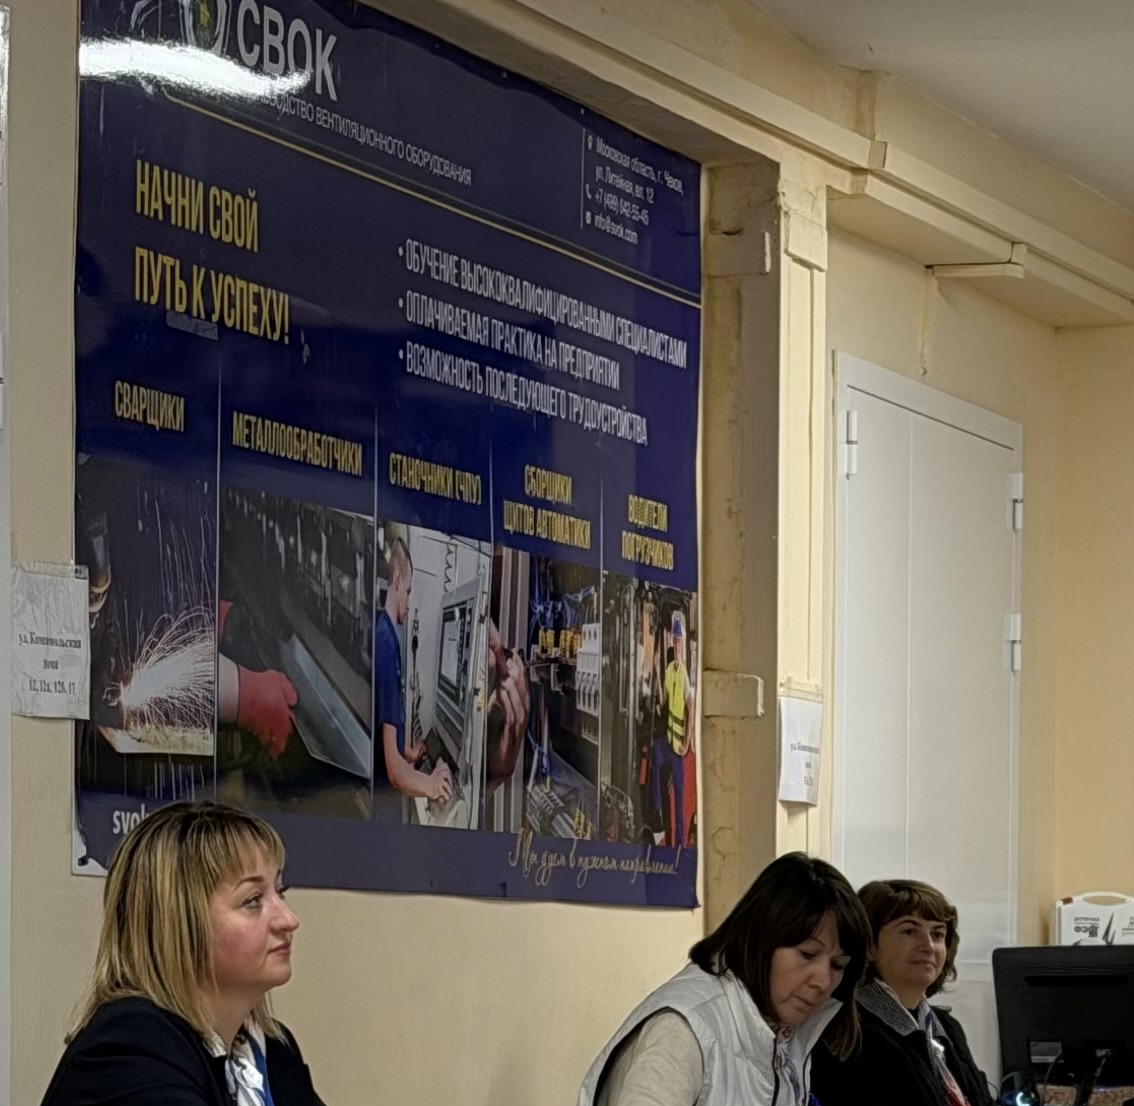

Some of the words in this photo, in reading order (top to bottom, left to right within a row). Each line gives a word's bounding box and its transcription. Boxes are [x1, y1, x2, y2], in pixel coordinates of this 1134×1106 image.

[237, 0, 338, 101] СВОК
[316, 106, 404, 159] ВЕНТИЛЯЦИОННОГО
[405, 141, 472, 187] ОБОРУДОВАНИЯ
[136, 159, 204, 235] НАЧНИ
[209, 186, 258, 253] СВОЙ
[135, 246, 188, 313] ПУТЬ
[192, 264, 206, 320] К
[210, 269, 289, 345] УСПЕХУ!
[405, 238, 459, 288] ОБУЧЕНИЕ
[460, 258, 614, 343] ВЫСОКОКВАЛИФИЦИРОВАННЫМИ
[615, 316, 688, 369] СПЕЦИАЛИСТАМИ
[406, 290, 489, 346] ОПЛАЧИВАЕМАЯ
[490, 318, 543, 362] ПРАКТИКА
[544, 339, 558, 368] НА
[558, 342, 620, 391] ПРЕДПРИЯТИИ
[115, 380, 185, 432] СВАРЩИКИ
[406, 340, 484, 395] ВОЗМОЖНОСТЬ
[485, 366, 566, 419] ПОСЛЕДУЮЩЕГО
[567, 392, 648, 446] ТРУДОУСТРОЙСТВА
[232, 411, 363, 477] МЕТАЛЛООБРАБОТЧИКИ
[389, 452, 454, 499] СТАНОЧНИКИ
[455, 470, 482, 506] (ЧПУ)
[524, 464, 572, 506] СБОРЩИКИ
[628, 494, 668, 532] ВОДИТЕЛИ
[503, 500, 535, 536] ЩИТОВ
[536, 508, 591, 550] АВТОМАТИКИ
[622, 530, 674, 571] ПОГРУЗЧИКОВ
